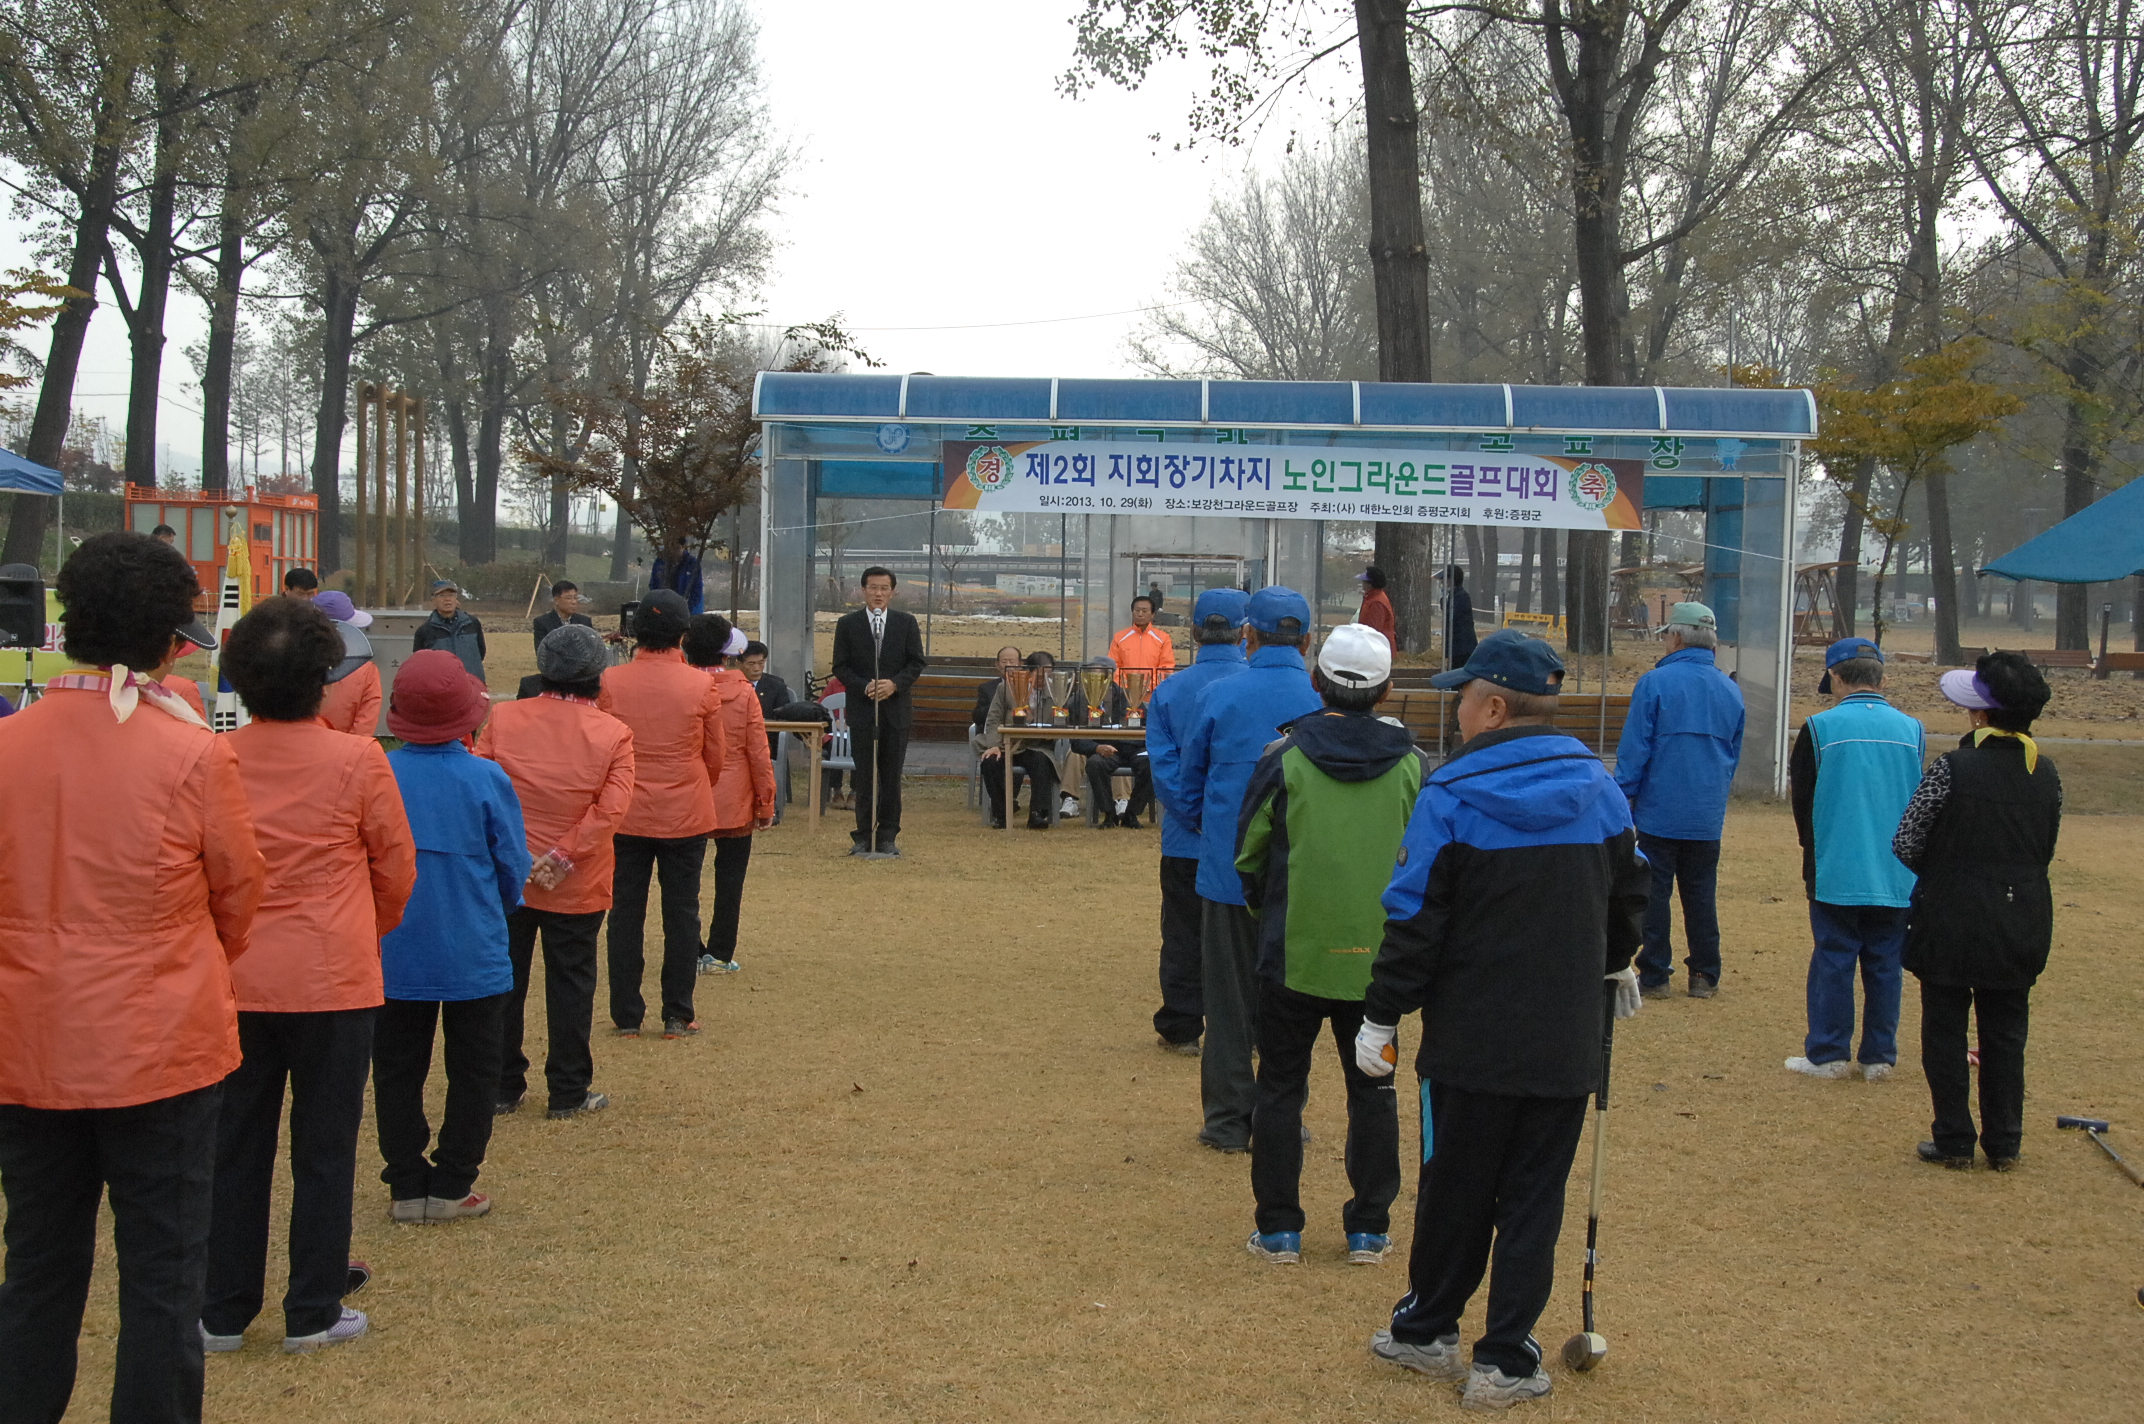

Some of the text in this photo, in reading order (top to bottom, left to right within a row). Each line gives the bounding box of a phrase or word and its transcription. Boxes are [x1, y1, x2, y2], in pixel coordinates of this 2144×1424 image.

[1650, 436, 1685, 470] 장
[979, 458, 1000, 483] 경
[1025, 453, 1558, 501] 제2회 지회장기차지 노인그라운드골프대회
[1579, 474, 1605, 501] 축
[1360, 503, 1413, 516] 대한노인회
[1417, 505, 1471, 518] 증평군지회
[1482, 507, 1542, 521] 후원:증평군
